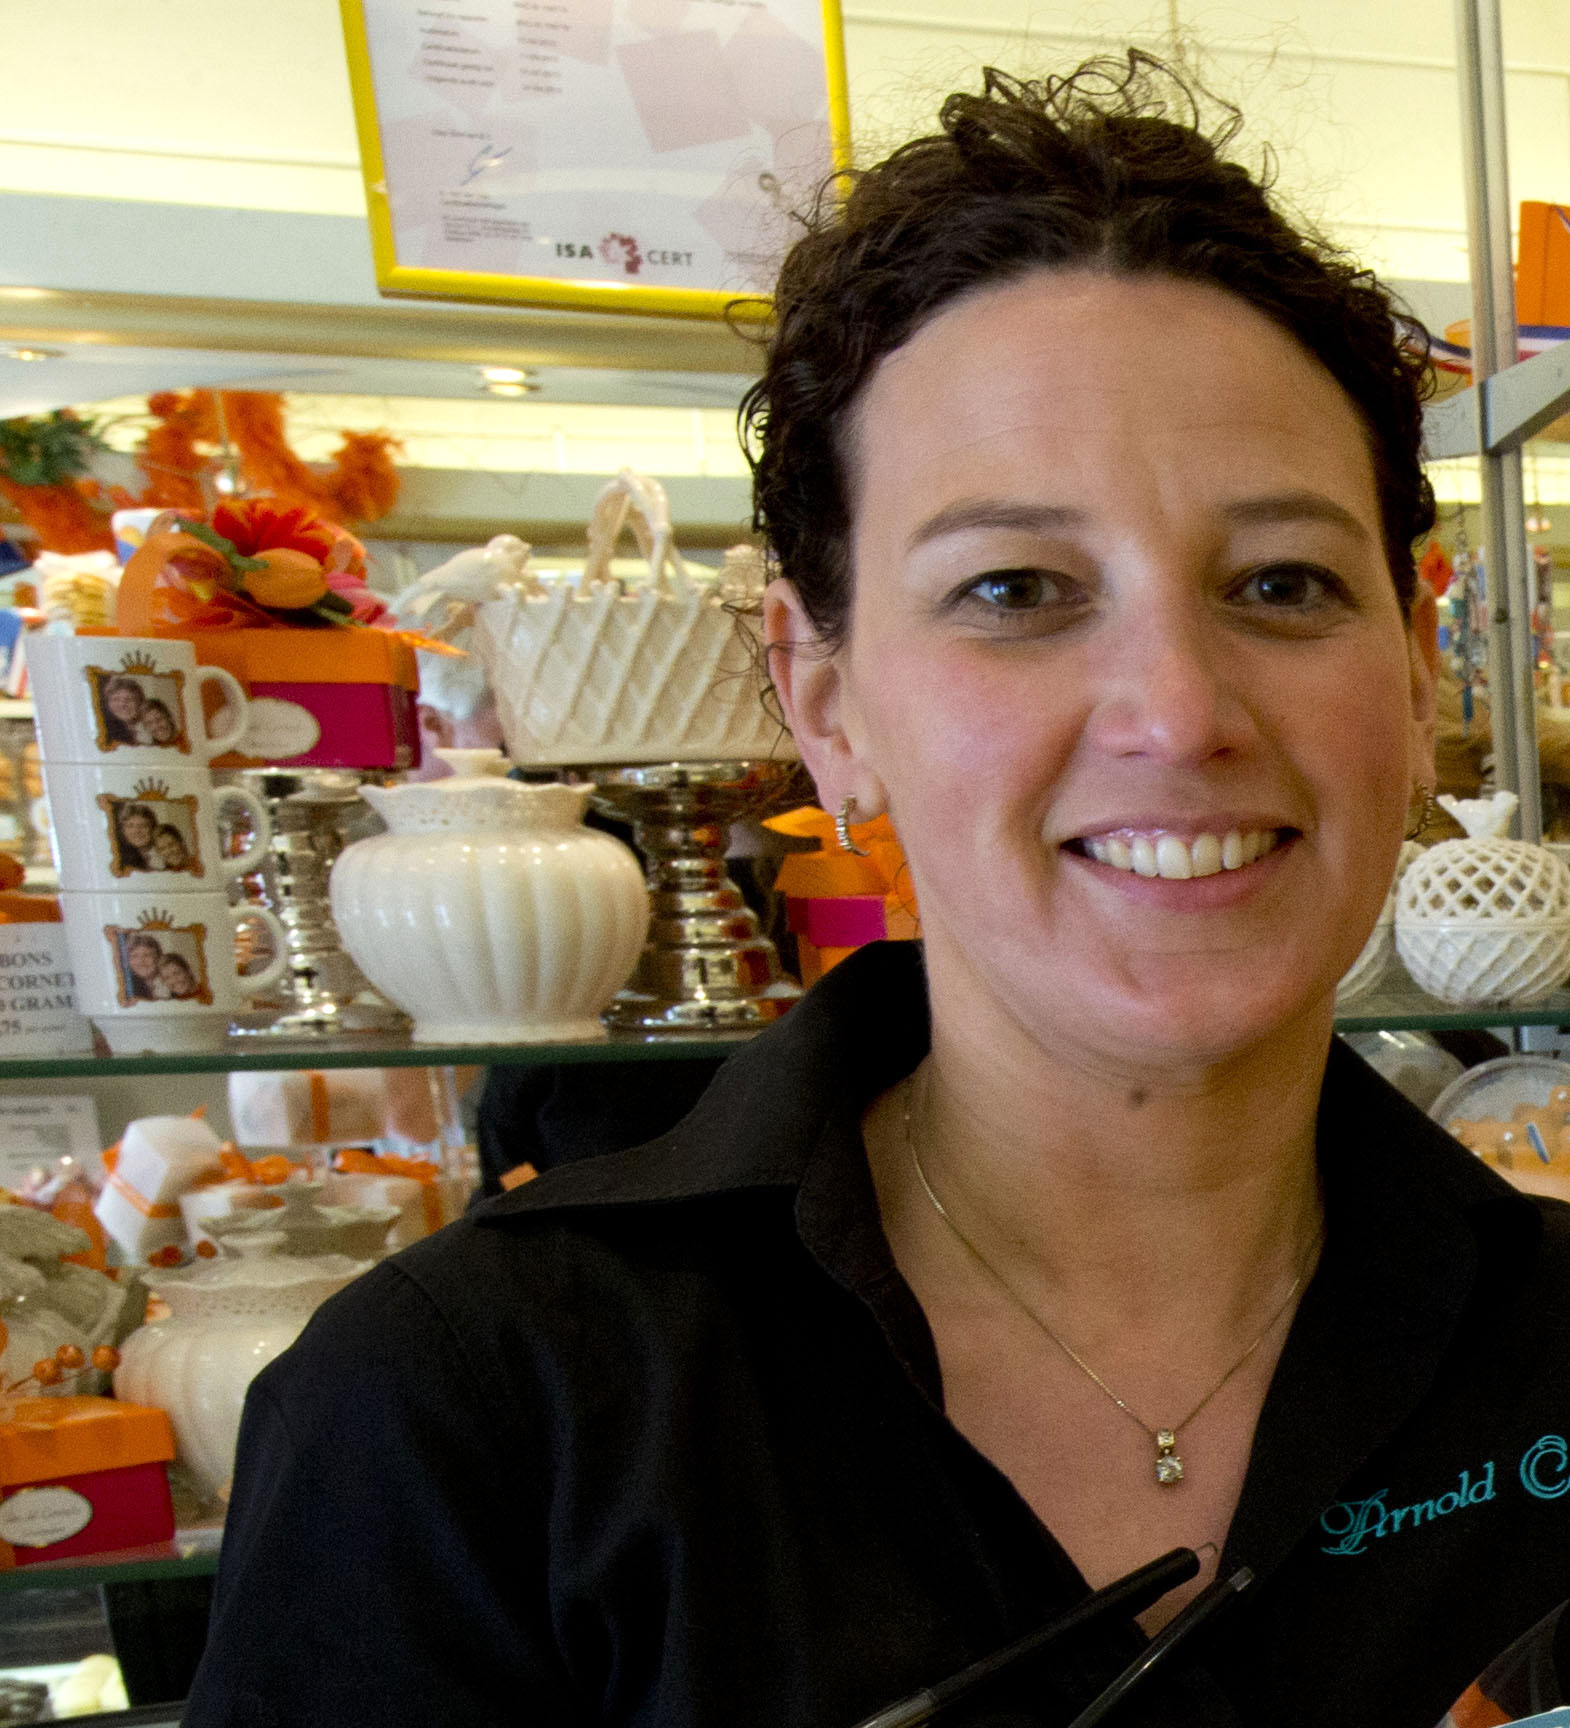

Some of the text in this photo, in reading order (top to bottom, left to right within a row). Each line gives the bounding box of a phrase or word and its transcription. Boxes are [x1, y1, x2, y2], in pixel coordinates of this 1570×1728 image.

[555, 242, 693, 267] ISA CERT
[1320, 1460, 1496, 1555] Arnold
